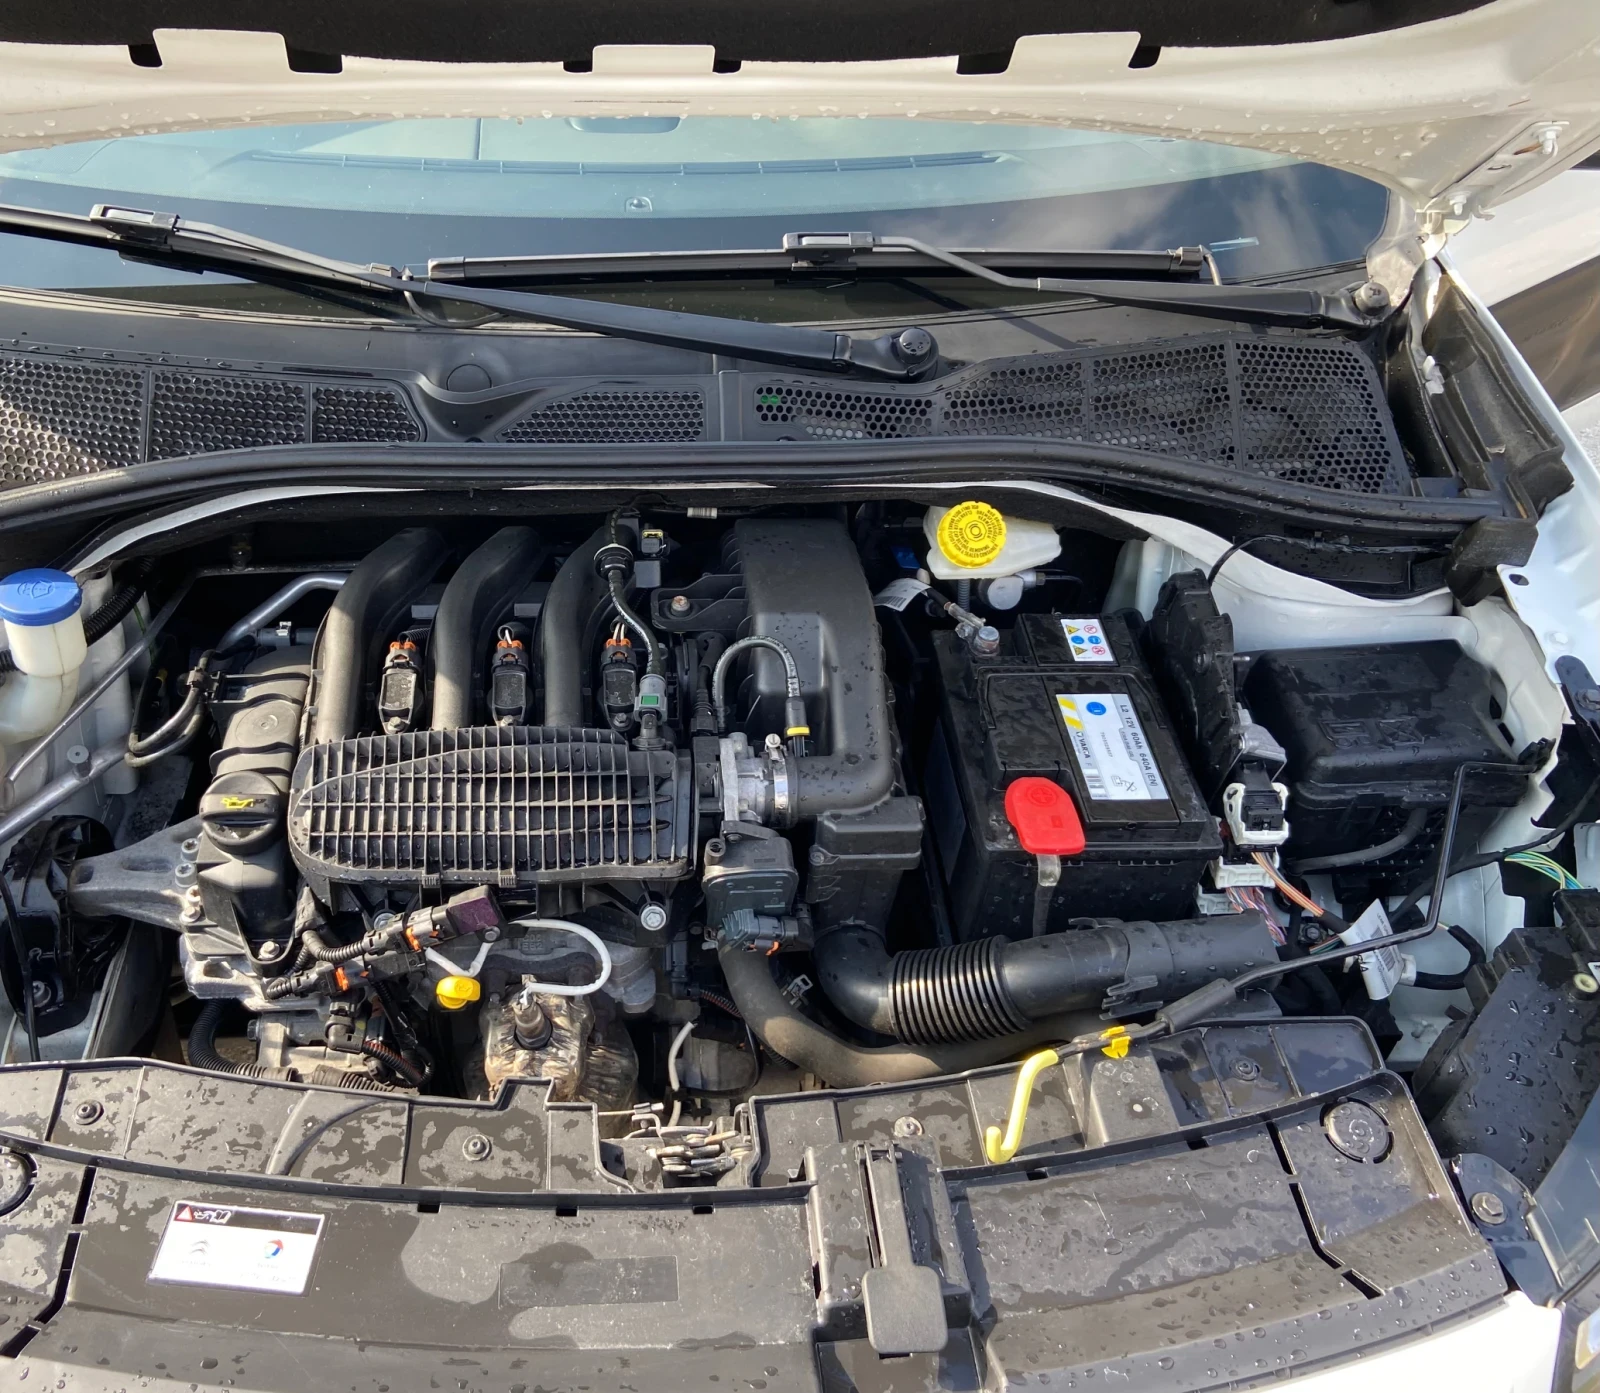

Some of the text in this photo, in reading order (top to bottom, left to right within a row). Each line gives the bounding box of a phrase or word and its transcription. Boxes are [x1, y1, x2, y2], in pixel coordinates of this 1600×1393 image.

[1120, 704, 1129, 713] L2
[1125, 717, 1135, 729] 12V
[1131, 732, 1143, 750] 60Ah
[1140, 752, 1151, 771] 640A
[1145, 772, 1158, 787] (EN)
